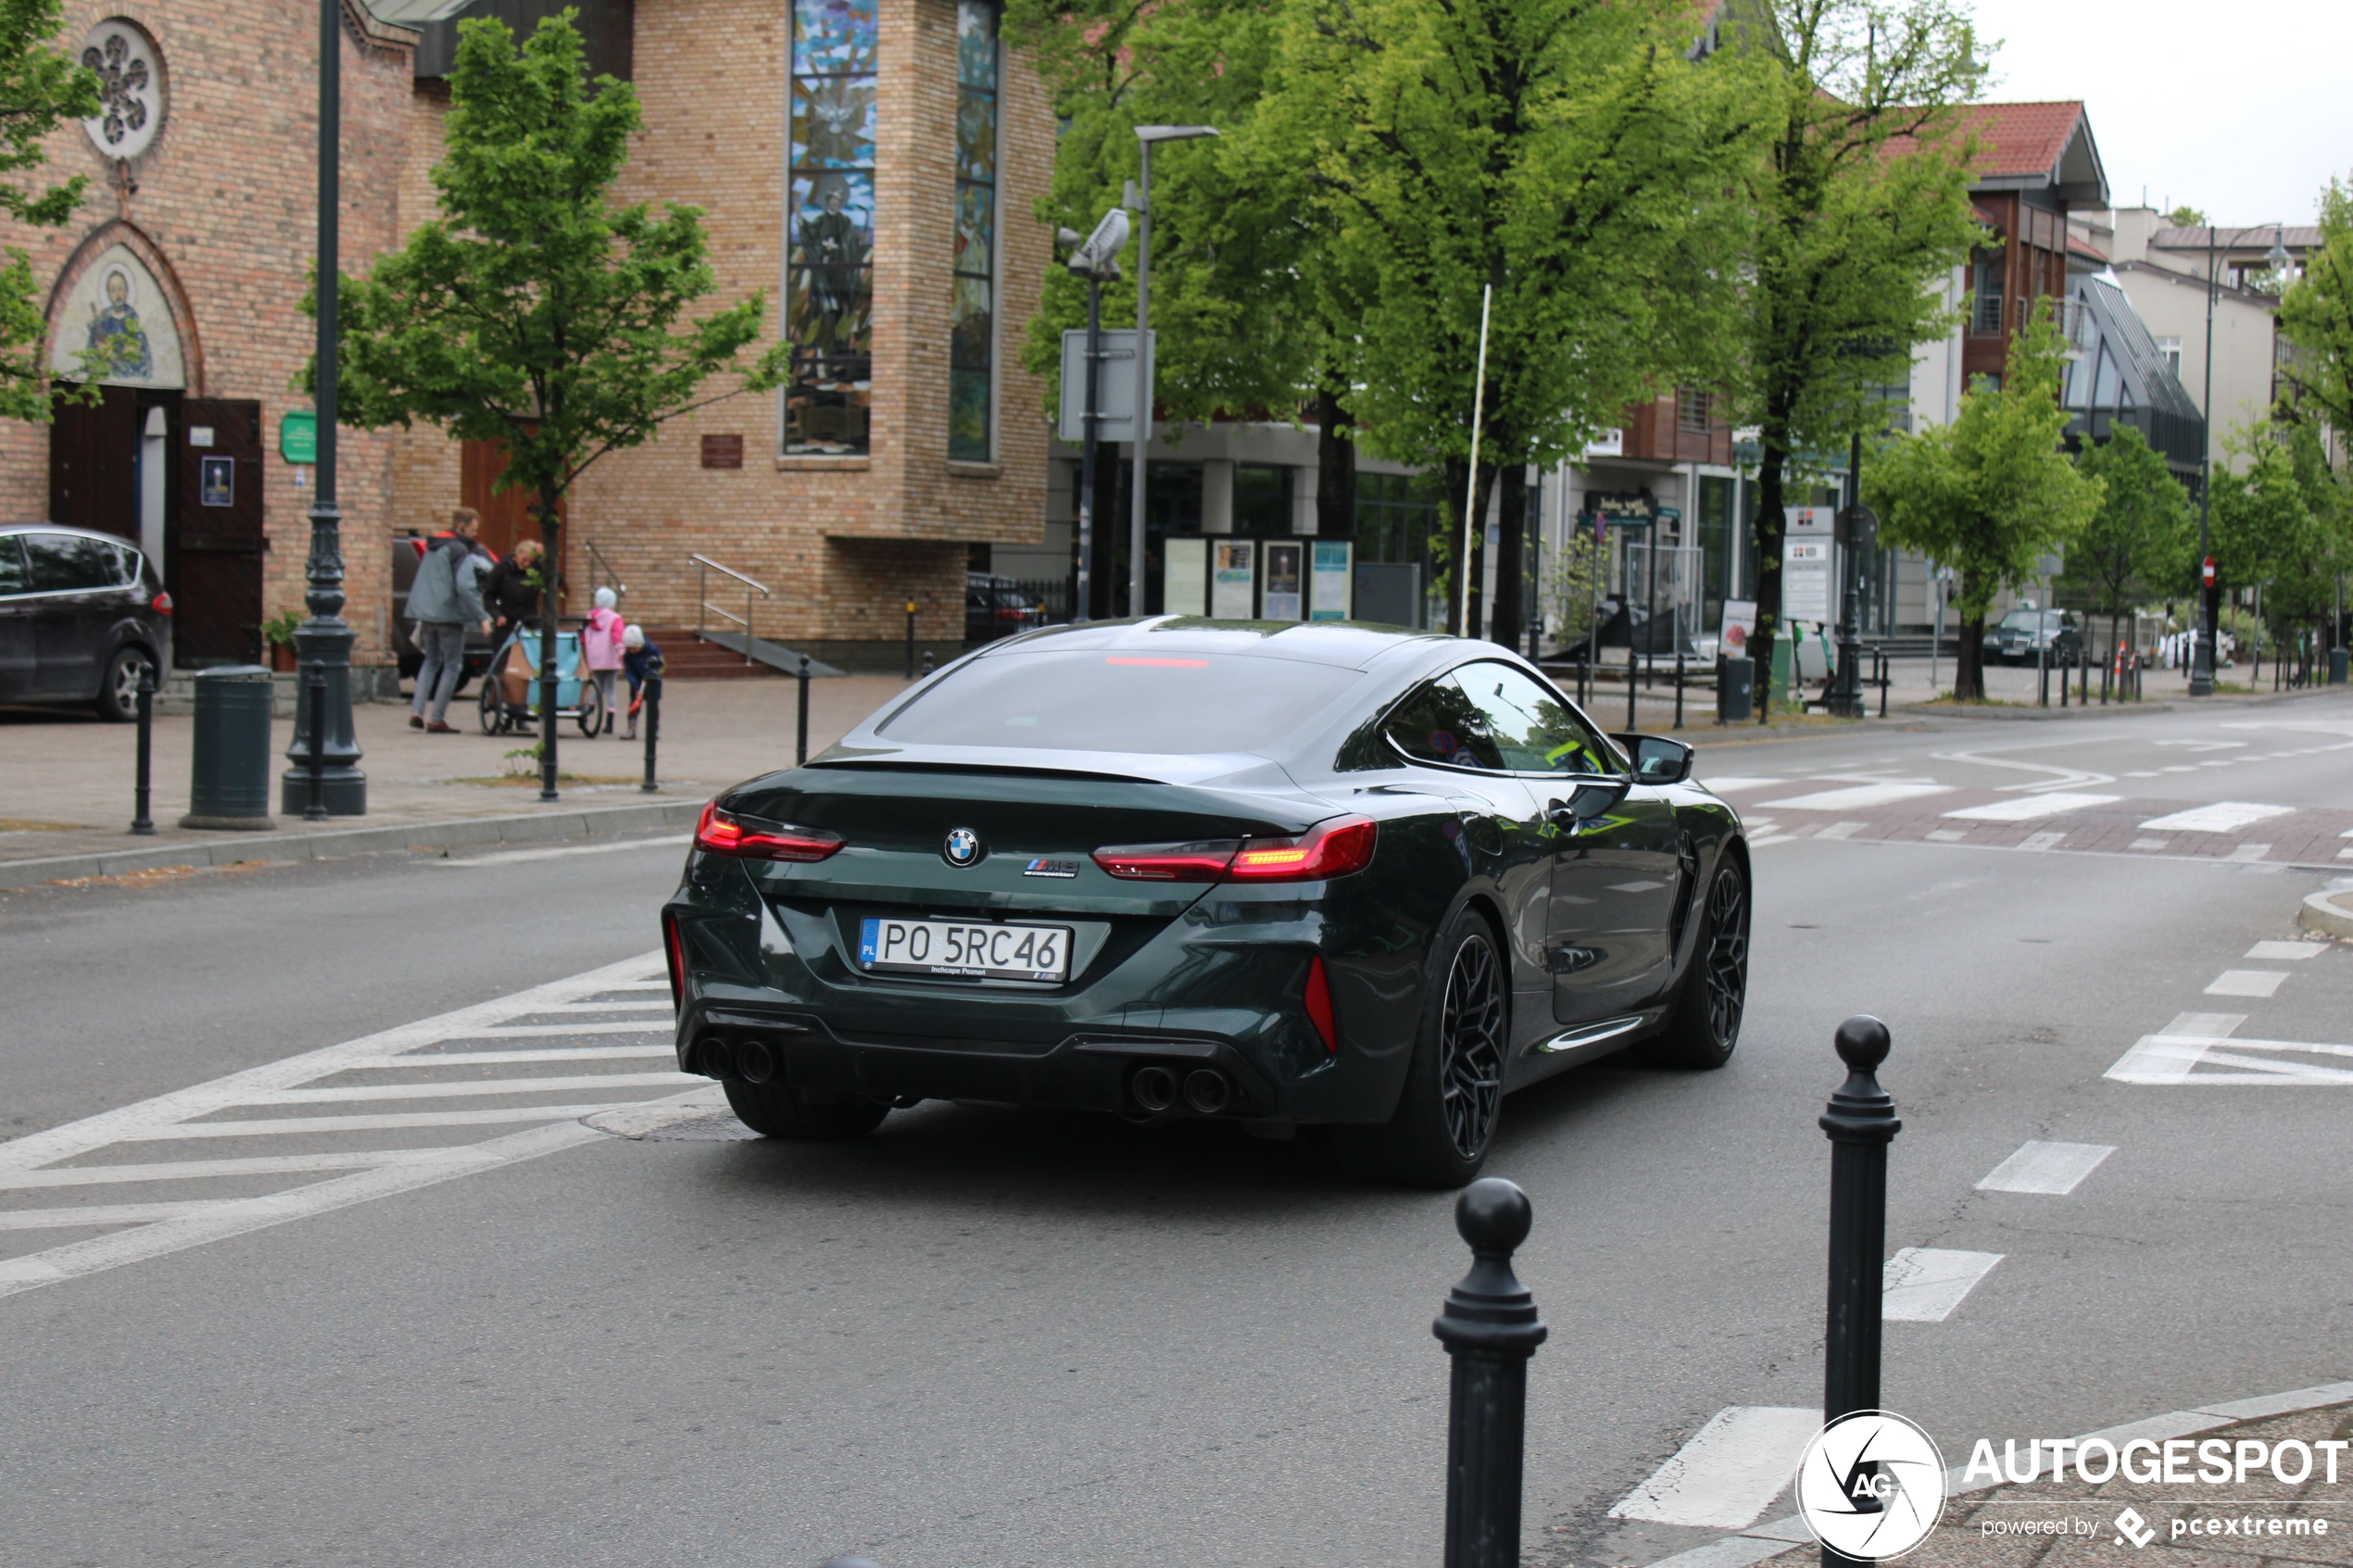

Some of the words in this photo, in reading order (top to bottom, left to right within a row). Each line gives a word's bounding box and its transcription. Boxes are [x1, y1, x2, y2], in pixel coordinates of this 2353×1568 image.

[948, 831, 975, 844] BMW
[1043, 859, 1080, 872] M8
[862, 945, 875, 956] PL
[884, 923, 930, 961] PO
[945, 927, 1058, 969] 5RC46
[931, 966, 961, 975] Inchcape
[962, 967, 986, 976] Poznań
